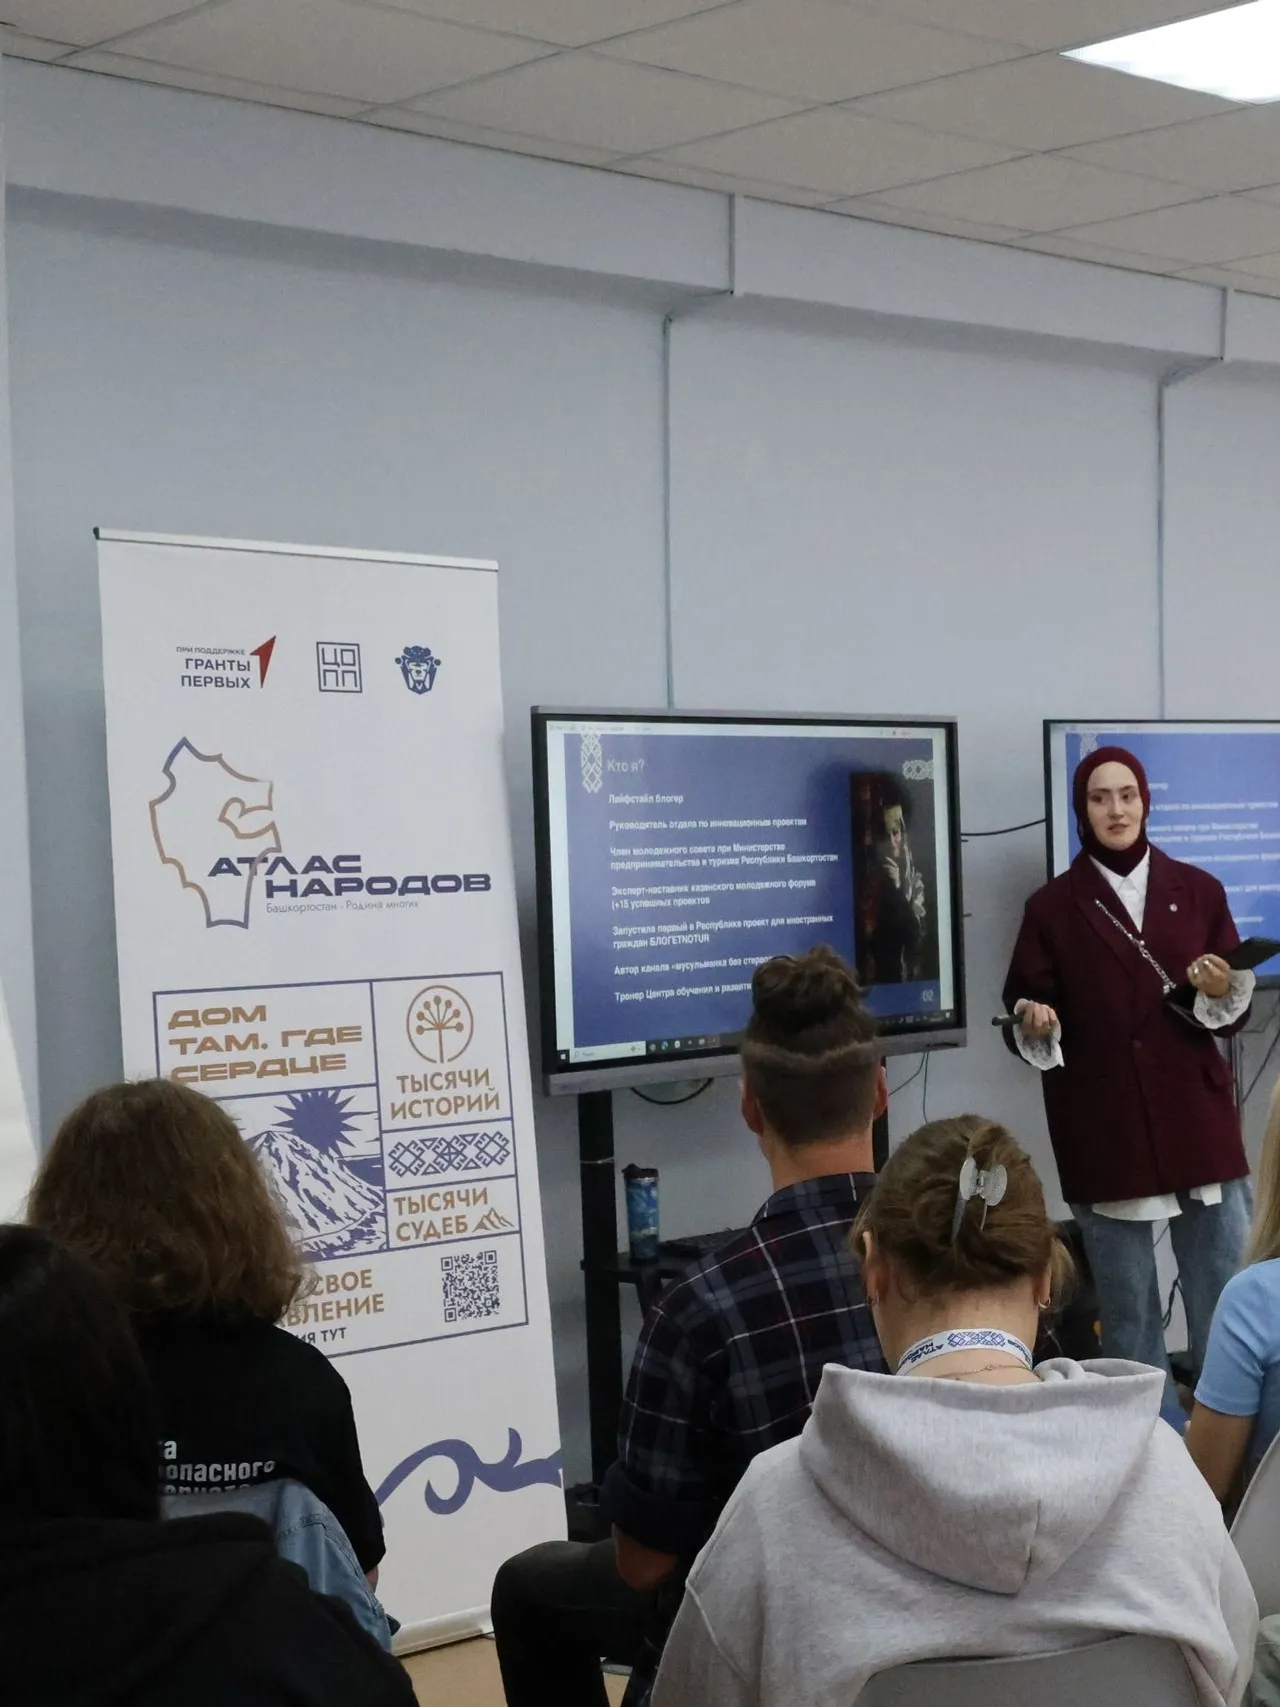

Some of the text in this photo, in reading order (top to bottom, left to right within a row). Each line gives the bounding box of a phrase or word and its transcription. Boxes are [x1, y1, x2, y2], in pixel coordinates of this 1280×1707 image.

[194, 647, 245, 655] ПОДДЕРЖКЕ
[185, 658, 251, 671] ГРАНТЫ
[181, 675, 251, 688] ПЕРВЫХ
[607, 758, 645, 772] Кто я?
[609, 794, 684, 805] Лайфстайл блогер
[610, 821, 667, 831] Руководитель
[669, 820, 697, 829] отдела
[699, 820, 708, 828] по
[772, 818, 807, 828] проектам
[610, 847, 630, 856] Член
[633, 846, 687, 856] молодежного
[689, 845, 716, 854] совета
[717, 844, 731, 854] при
[207, 855, 362, 876] АТЛАС
[610, 859, 700, 870] предпринимательства
[708, 857, 739, 868] туризма
[787, 853, 838, 864] Башкортостан
[266, 873, 491, 898] НАРОДОВ
[611, 884, 689, 897] Эксперт-наставник
[788, 878, 817, 889] форума
[266, 902, 337, 914] Башкортостан
[346, 900, 383, 911] Родина
[386, 899, 419, 910] многих
[631, 898, 671, 910] успешных
[673, 896, 710, 907] проектов
[613, 925, 656, 936] Запустила
[658, 922, 688, 934] первый
[743, 918, 769, 928] проект
[771, 917, 785, 927] для
[613, 939, 648, 950] граждан
[614, 965, 639, 976] Автор
[641, 963, 670, 973] канала
[728, 957, 742, 967] без
[614, 991, 644, 1003] Тренер
[646, 988, 675, 1000] Центра
[676, 985, 713, 997] обучения
[721, 982, 752, 995] развити
[168, 1005, 267, 1030] ДОМ
[281, 1025, 362, 1047] ГДЕ
[170, 1053, 346, 1083] СЕРДЦЕ
[397, 1068, 489, 1093] ТЫСЯЧИ
[390, 1087, 500, 1120] ИСТОРИЙ
[393, 1187, 488, 1216] ТЫСЯЧИ
[396, 1215, 468, 1242] СУДЕБ
[309, 1269, 372, 1296] СВОЕ
[320, 1327, 347, 1342] ТУТ
[160, 1460, 276, 1482] опасного
